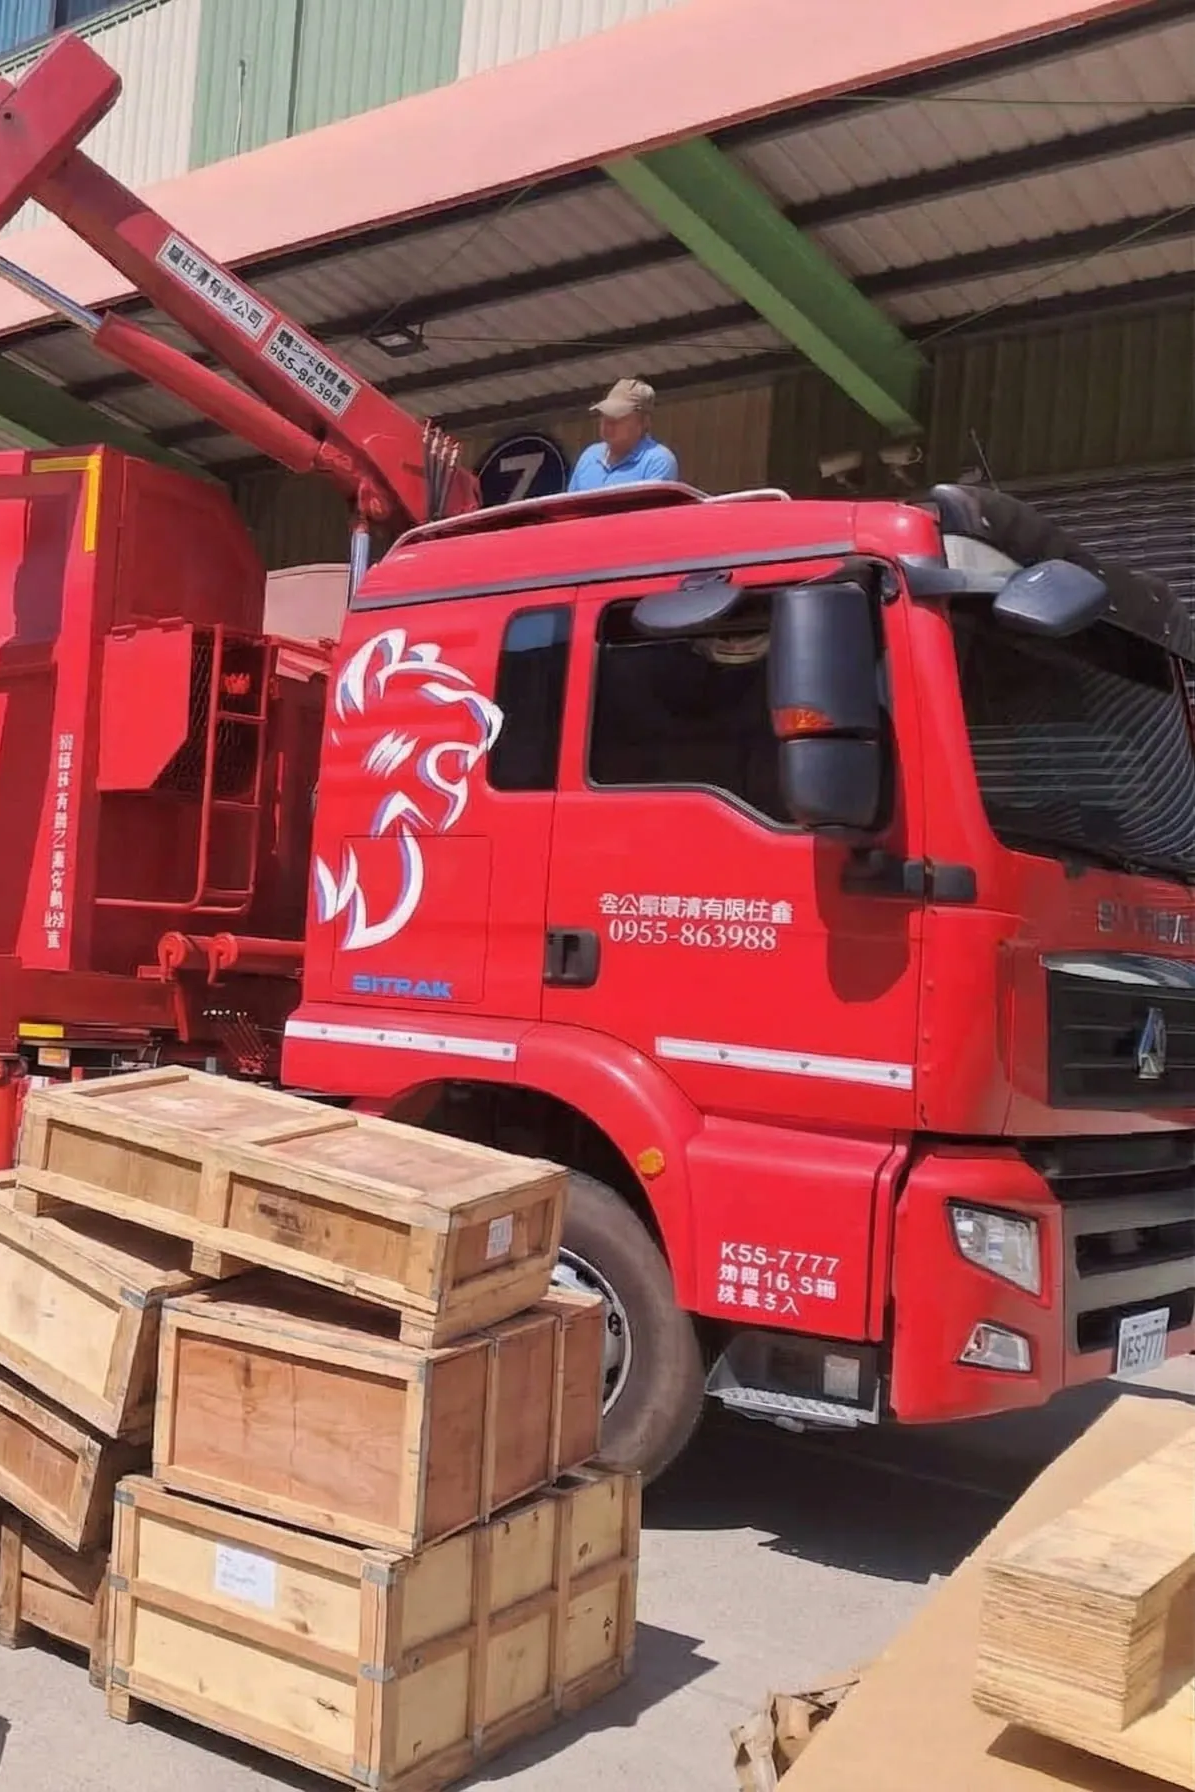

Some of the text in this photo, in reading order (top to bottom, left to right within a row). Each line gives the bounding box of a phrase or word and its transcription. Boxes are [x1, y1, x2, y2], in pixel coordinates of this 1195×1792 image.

[500, 452, 546, 503] 7
[609, 918, 777, 950] 0955-863988
[352, 974, 453, 999] SITRAK
